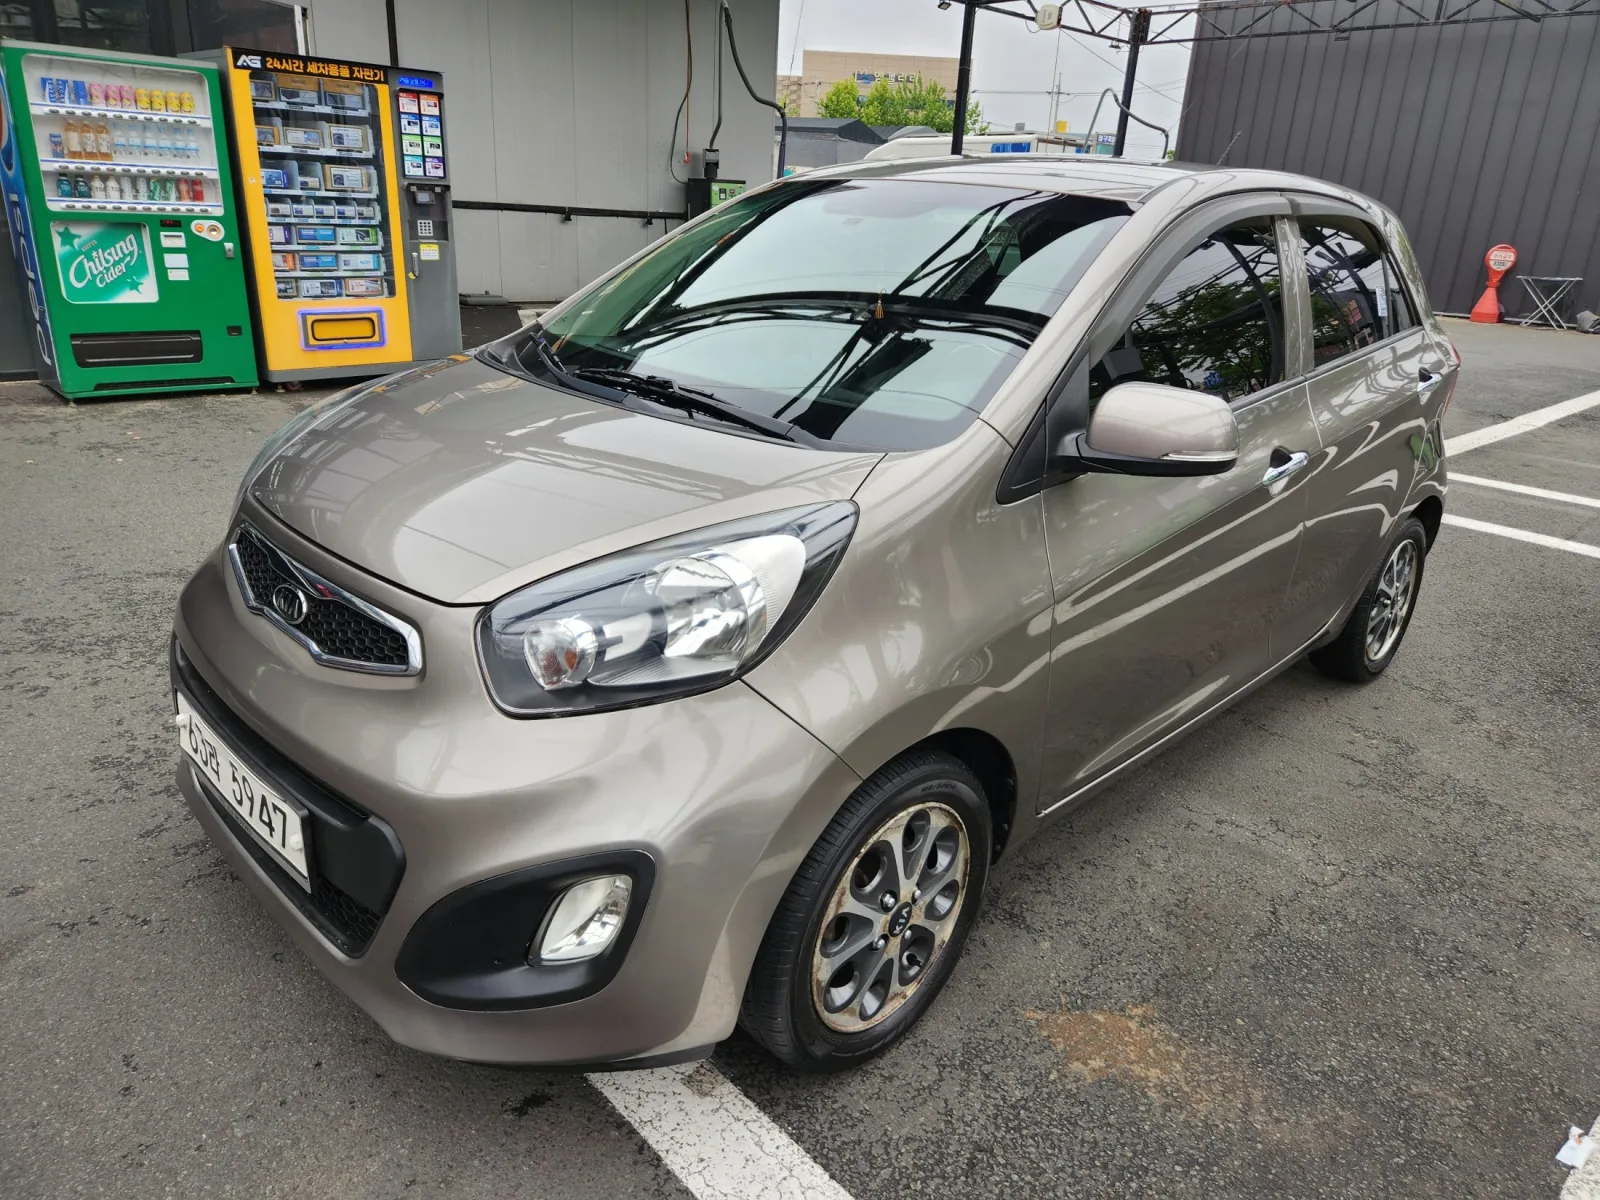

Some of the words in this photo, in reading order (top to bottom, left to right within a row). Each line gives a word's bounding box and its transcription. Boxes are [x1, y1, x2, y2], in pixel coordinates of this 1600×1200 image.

[236, 54, 262, 69] AG
[265, 57, 304, 73] 24시간
[306, 61, 350, 78] 세차용품
[352, 66, 384, 82] 자판기
[69, 233, 138, 288] Chilsung
[95, 255, 131, 288] Cider
[229, 759, 287, 849] 5947
[892, 906, 910, 934] KIA
